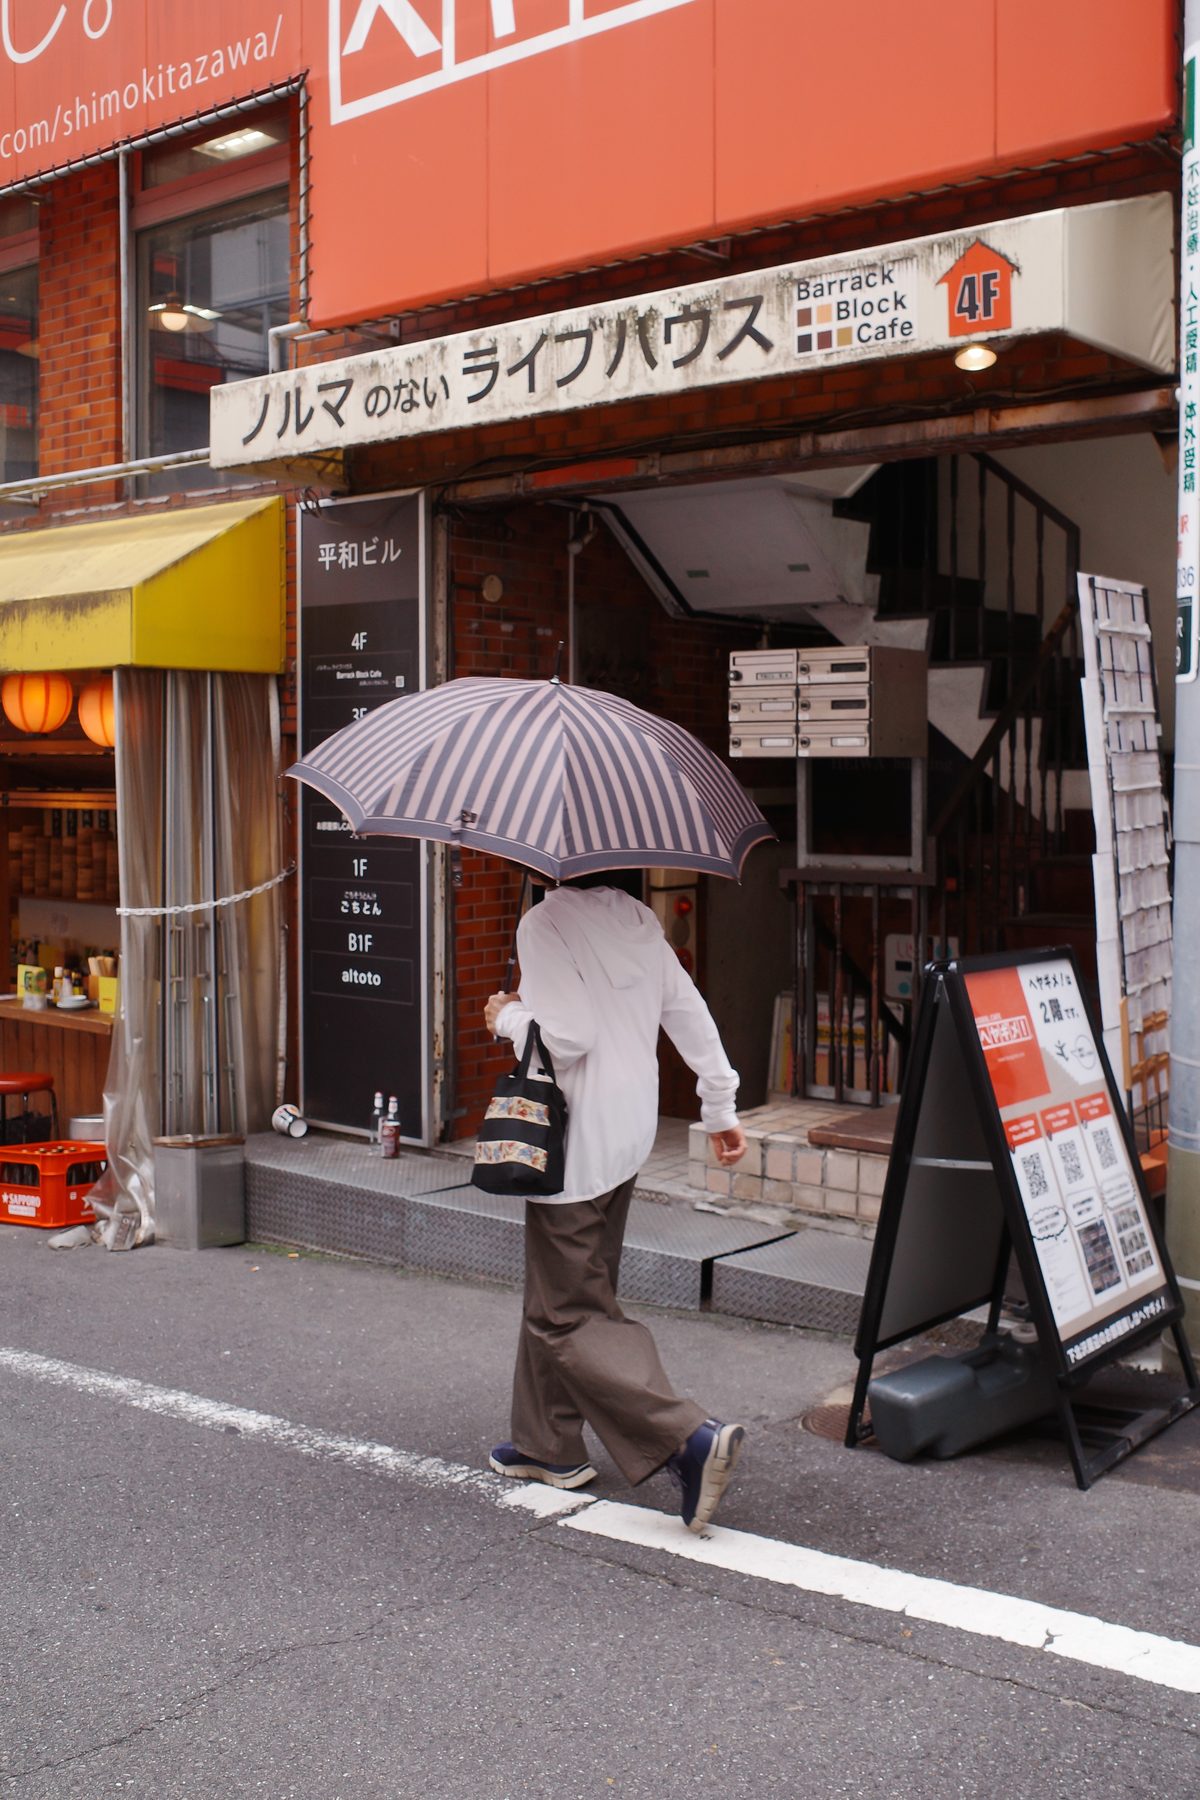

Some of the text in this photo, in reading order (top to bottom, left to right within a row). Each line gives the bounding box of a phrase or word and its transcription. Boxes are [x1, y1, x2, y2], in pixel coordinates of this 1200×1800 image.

[797, 266, 895, 301] Barrack
[836, 291, 907, 320] Block
[955, 270, 1000, 322] 4F
[857, 317, 913, 344] Cafe
[317, 537, 402, 571] 平和ビル
[351, 631, 367, 650] 4F
[352, 858, 368, 877] 1F
[341, 900, 382, 916] ごちとん
[348, 932, 373, 952] B1F
[341, 968, 382, 986] altoto
[9, 1192, 41, 1208] SAPPORO
